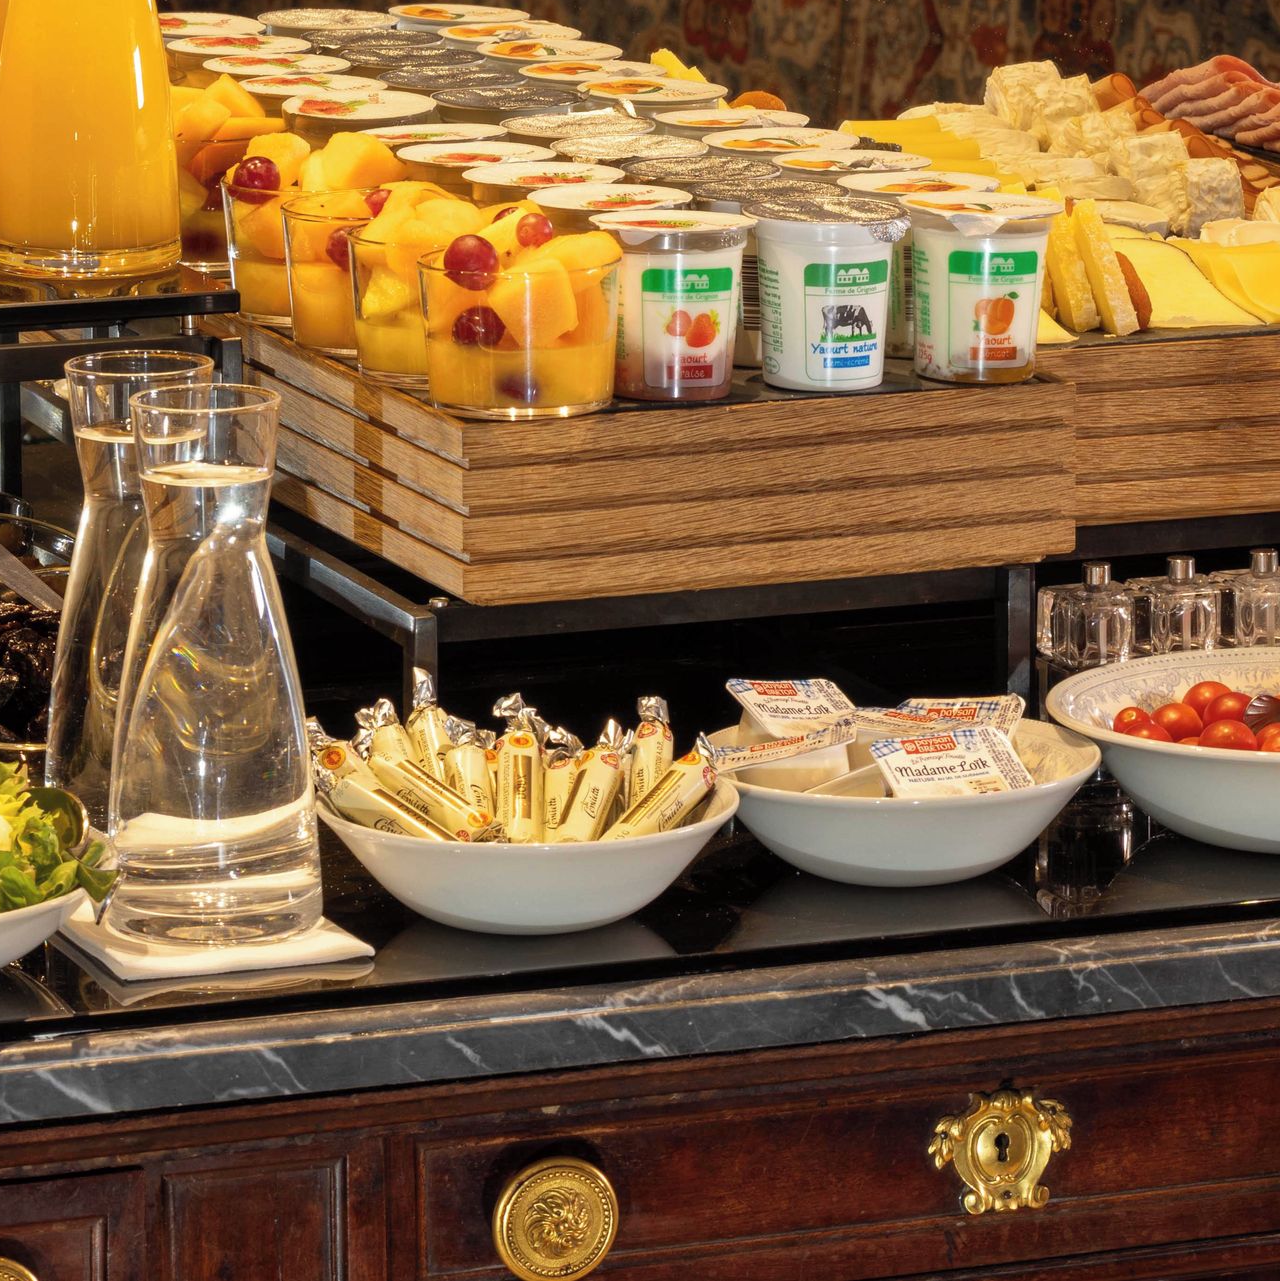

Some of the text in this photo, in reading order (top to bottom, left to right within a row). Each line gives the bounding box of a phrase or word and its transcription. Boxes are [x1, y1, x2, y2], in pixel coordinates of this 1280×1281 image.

[853, 341, 877, 353] nature
[676, 367, 705, 378] raise
[753, 702, 805, 715] Madame
[939, 708, 975, 719] paysan
[914, 736, 952, 747] paysan
[918, 742, 955, 753] BRETON
[894, 764, 959, 778] Madame
